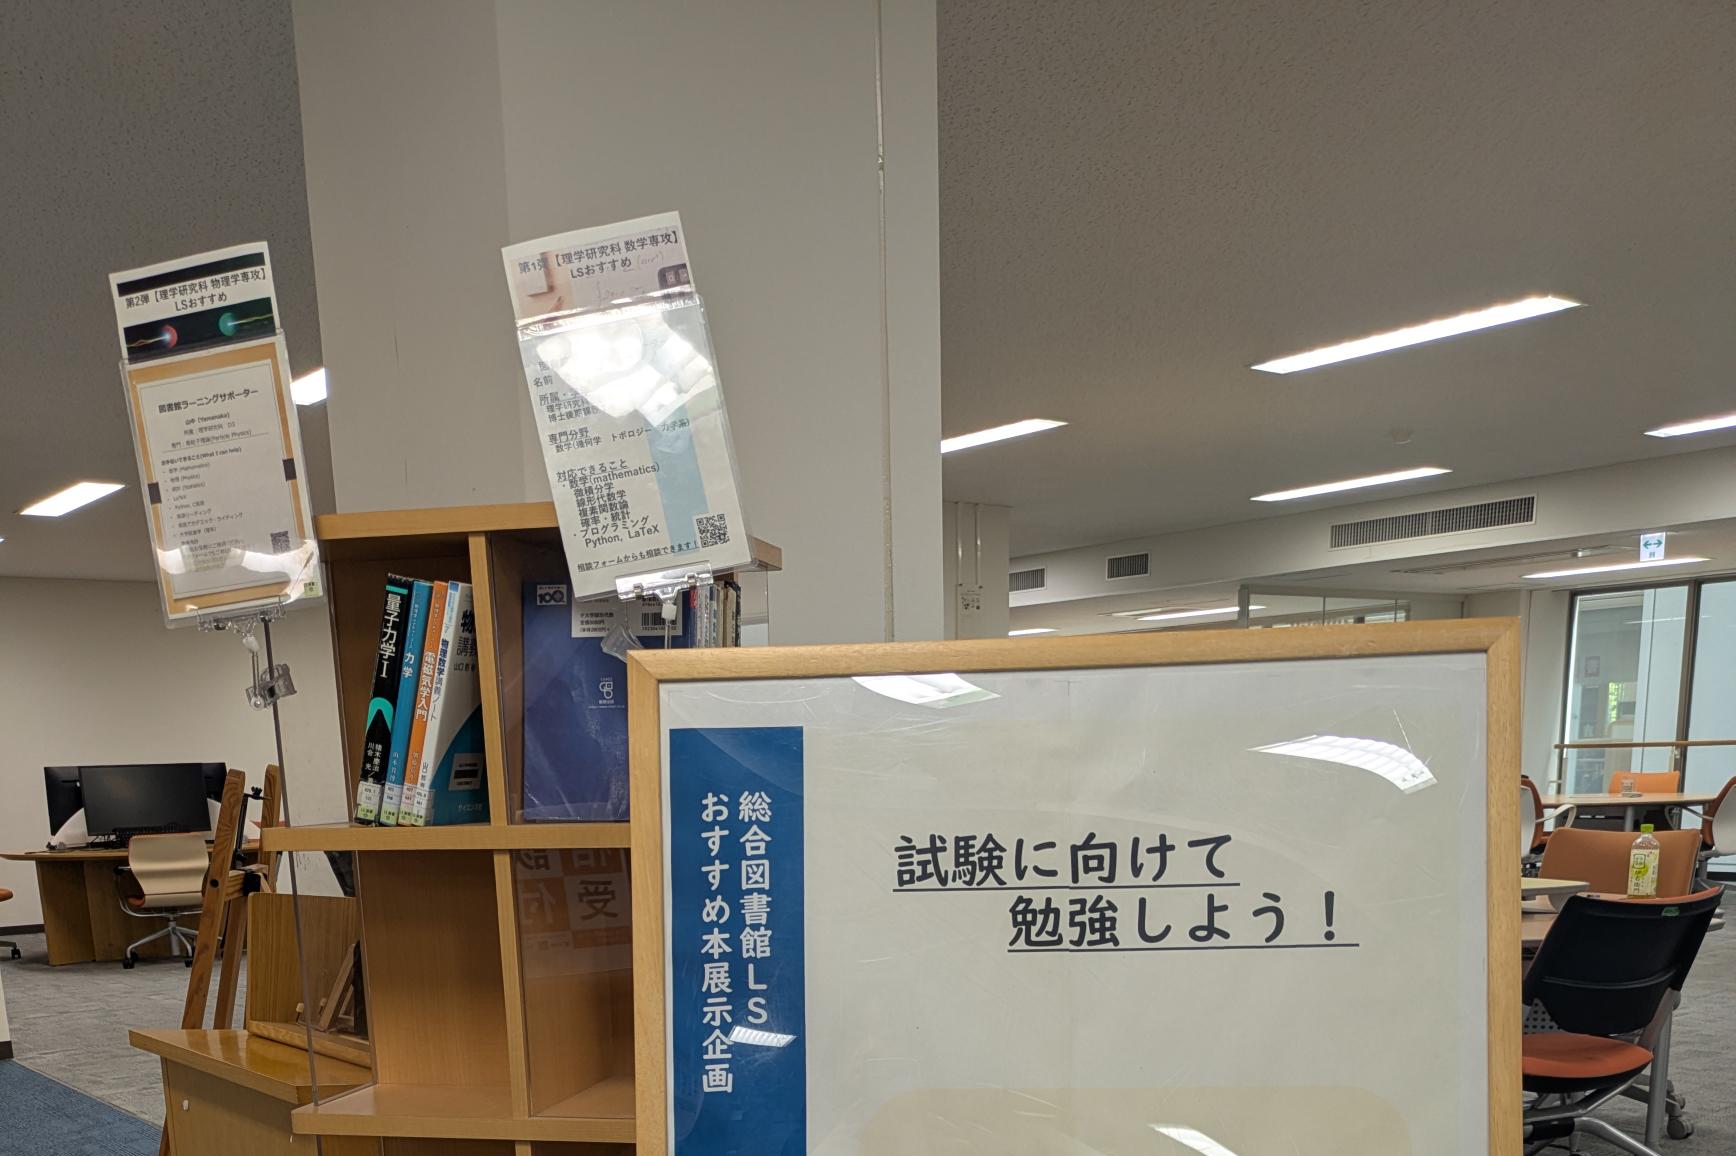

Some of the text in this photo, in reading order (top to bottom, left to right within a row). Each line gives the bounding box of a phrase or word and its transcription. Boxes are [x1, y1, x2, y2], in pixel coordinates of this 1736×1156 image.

[210, 267, 267, 289] 物理学専攻】
[570, 257, 632, 279] LSおすすめ
[175, 292, 228, 311] LSおすすめ
[533, 375, 553, 388] 名前
[548, 426, 589, 445] 専門分野
[556, 459, 629, 482] 対応できること
[574, 482, 615, 498] 微積分学
[576, 489, 627, 508] 線形代数学
[627, 524, 660, 539] LaTeX
[402, 652, 415, 678] 力学
[894, 832, 1232, 888] 試験に向けて
[738, 791, 772, 1025] 総合図書館LS
[1008, 890, 1336, 948] 勉強しよう！
[700, 792, 734, 1094] おすすめ本展示企画
